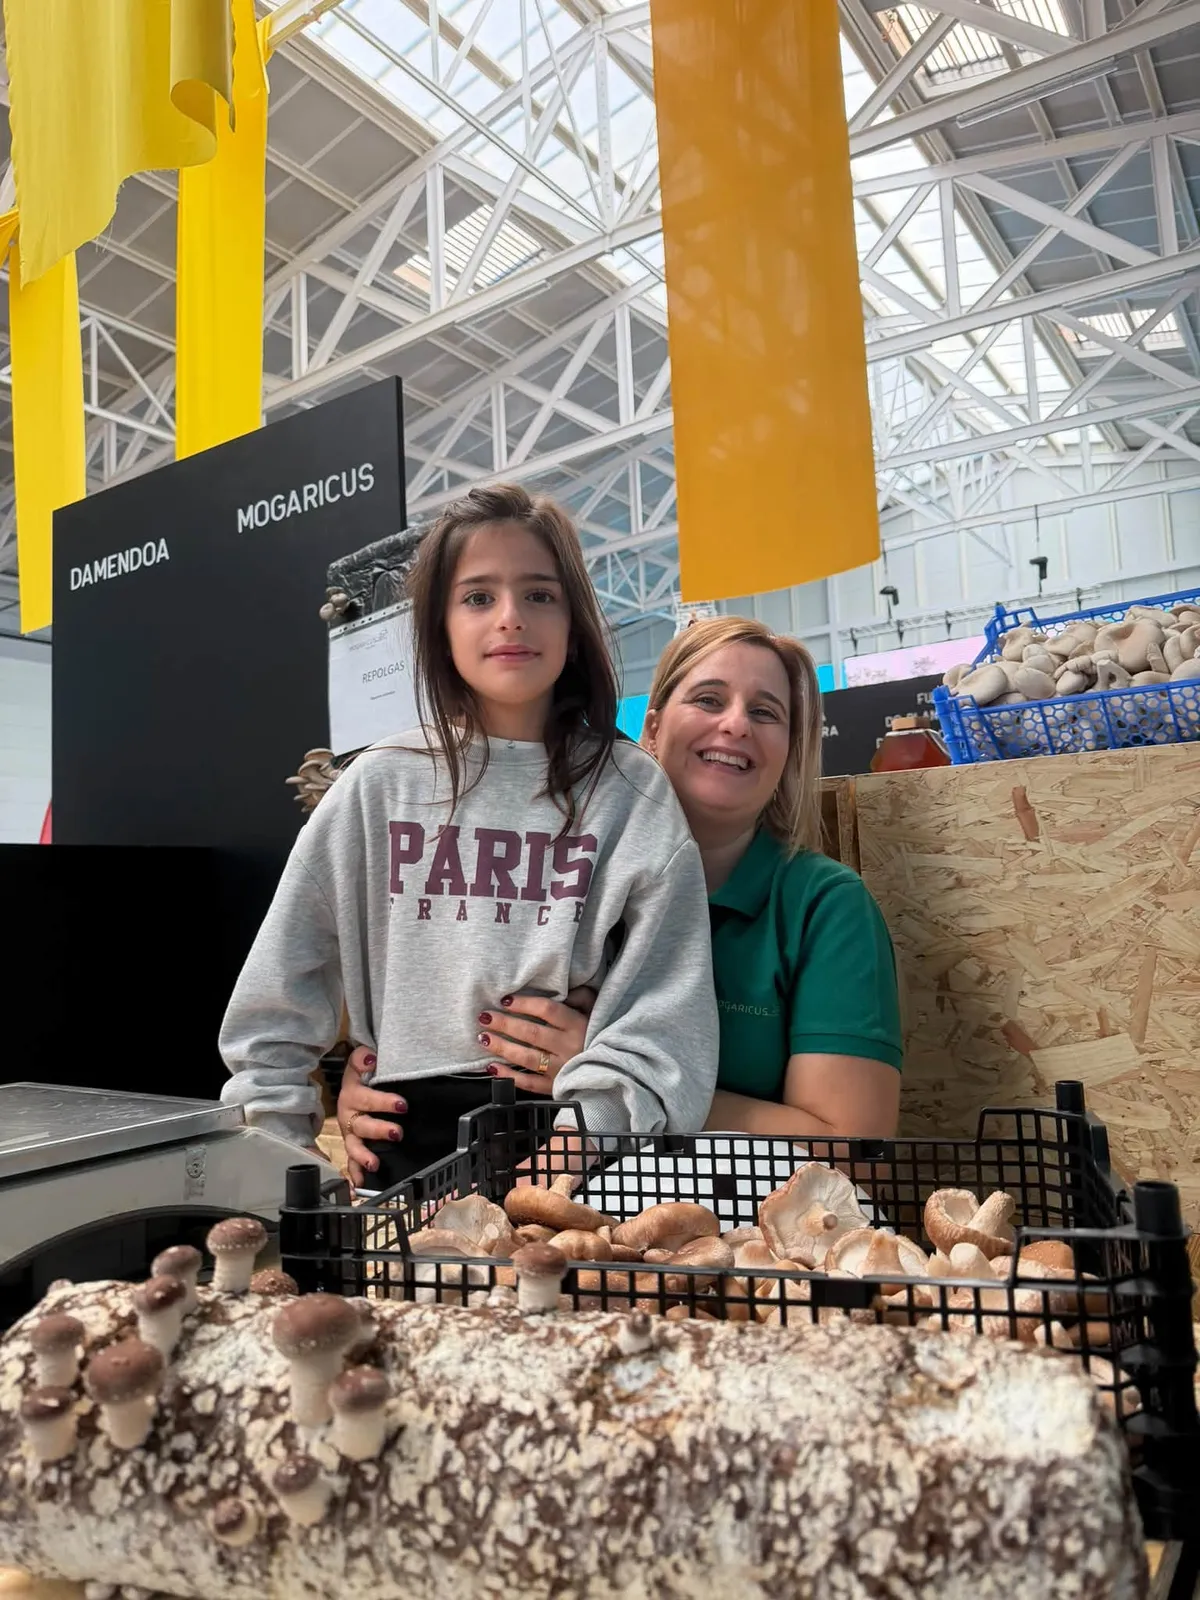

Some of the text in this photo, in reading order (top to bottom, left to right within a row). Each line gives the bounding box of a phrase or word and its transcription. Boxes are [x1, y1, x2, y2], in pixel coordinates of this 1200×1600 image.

[237, 462, 376, 534] MOGARICUS
[70, 537, 170, 592] DAMENDOA
[362, 659, 405, 685] REPOLGAS
[388, 820, 598, 902] PARIS
[389, 897, 585, 926] RANCE
[718, 999, 769, 1016] OGARICUS
